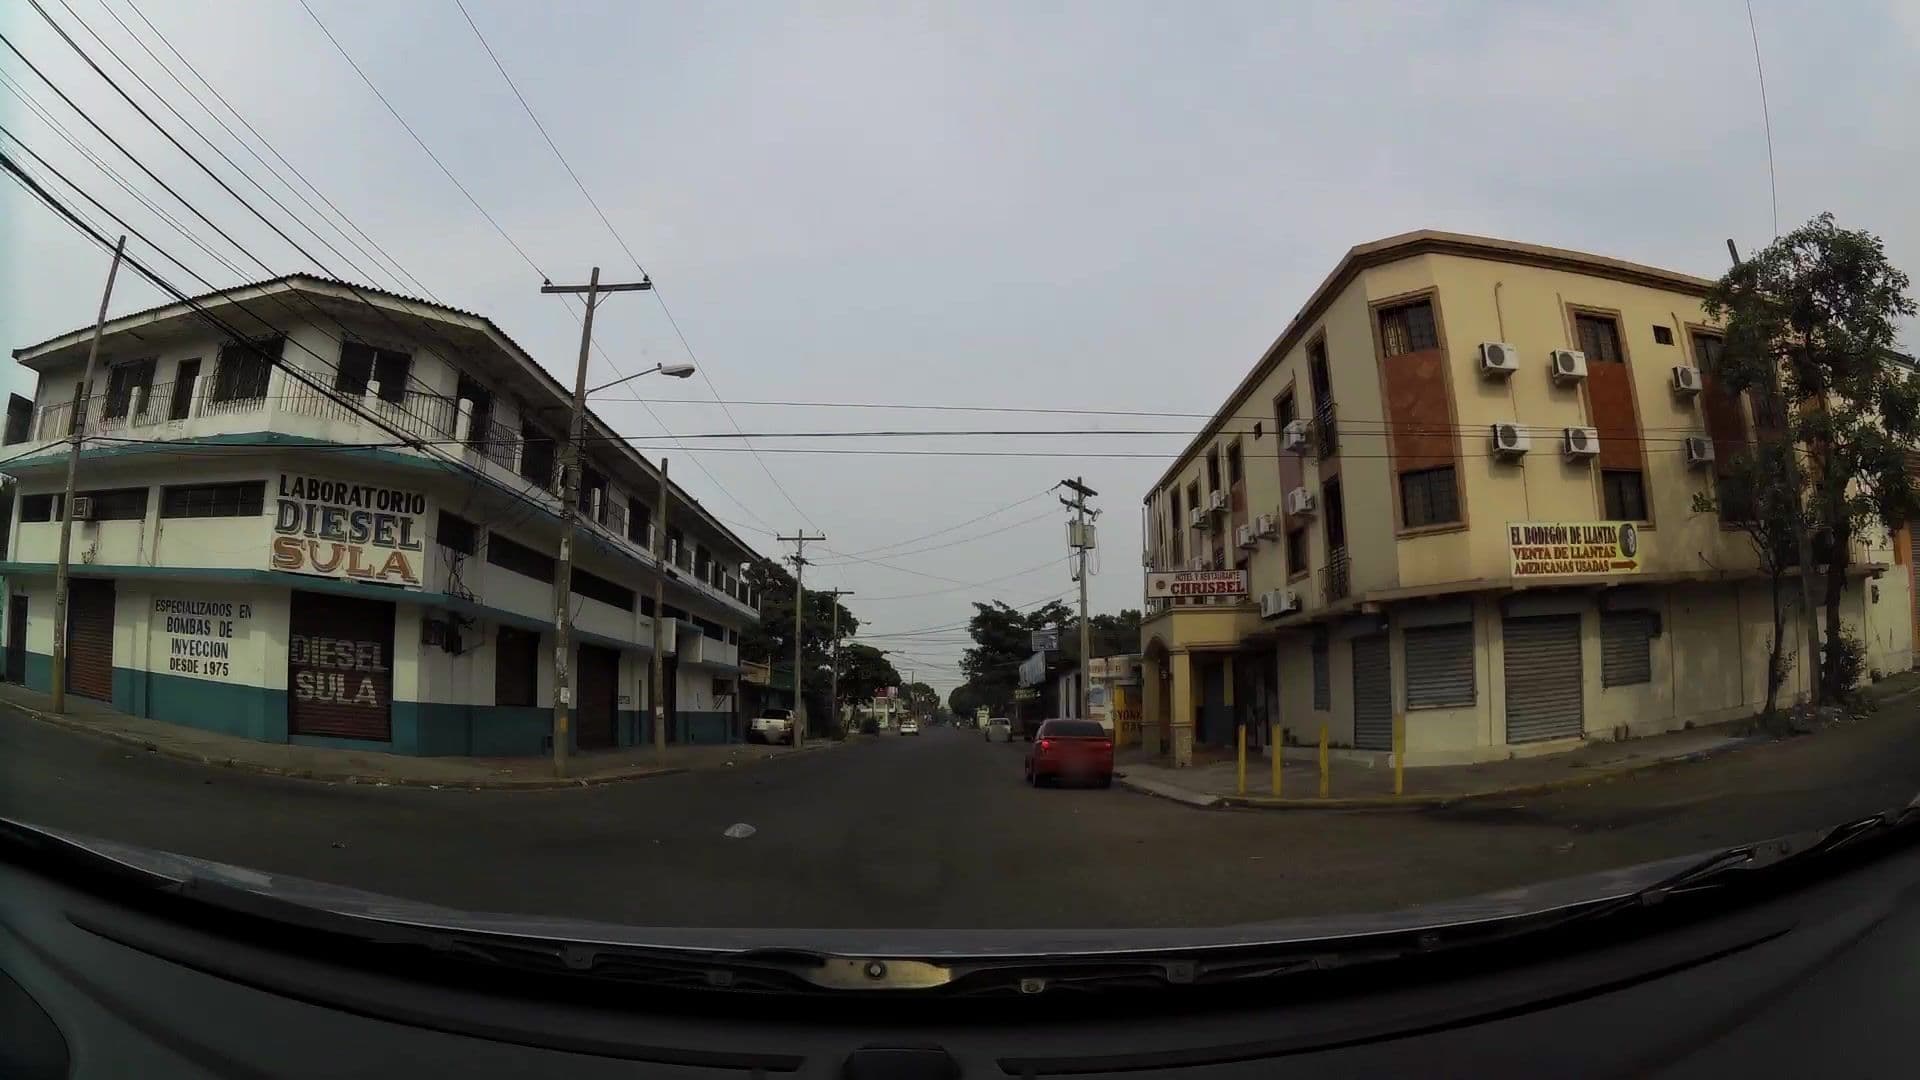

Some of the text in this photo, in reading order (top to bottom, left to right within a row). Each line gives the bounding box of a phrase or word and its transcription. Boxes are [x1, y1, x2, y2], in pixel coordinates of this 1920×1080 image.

[279, 474, 425, 515] LABORATORIO
[274, 499, 422, 552] DIESEL
[1511, 522, 1617, 545] EL BODEGÓN DE LLANTAS
[272, 536, 419, 584] SULA
[1513, 546, 1616, 560] VENTA DE LLANTAS
[1514, 560, 1609, 574] AMERICANAS USADAS
[1170, 581, 1245, 594] CHRISBEL
[155, 600, 251, 619] ESPECIALIZADOS EN
[167, 616, 232, 638] BOMBAS DE
[171, 638, 228, 658] INYECCION
[289, 634, 388, 672] DIESEL
[169, 657, 228, 676] DESDE 1975
[296, 671, 379, 708] SULA
